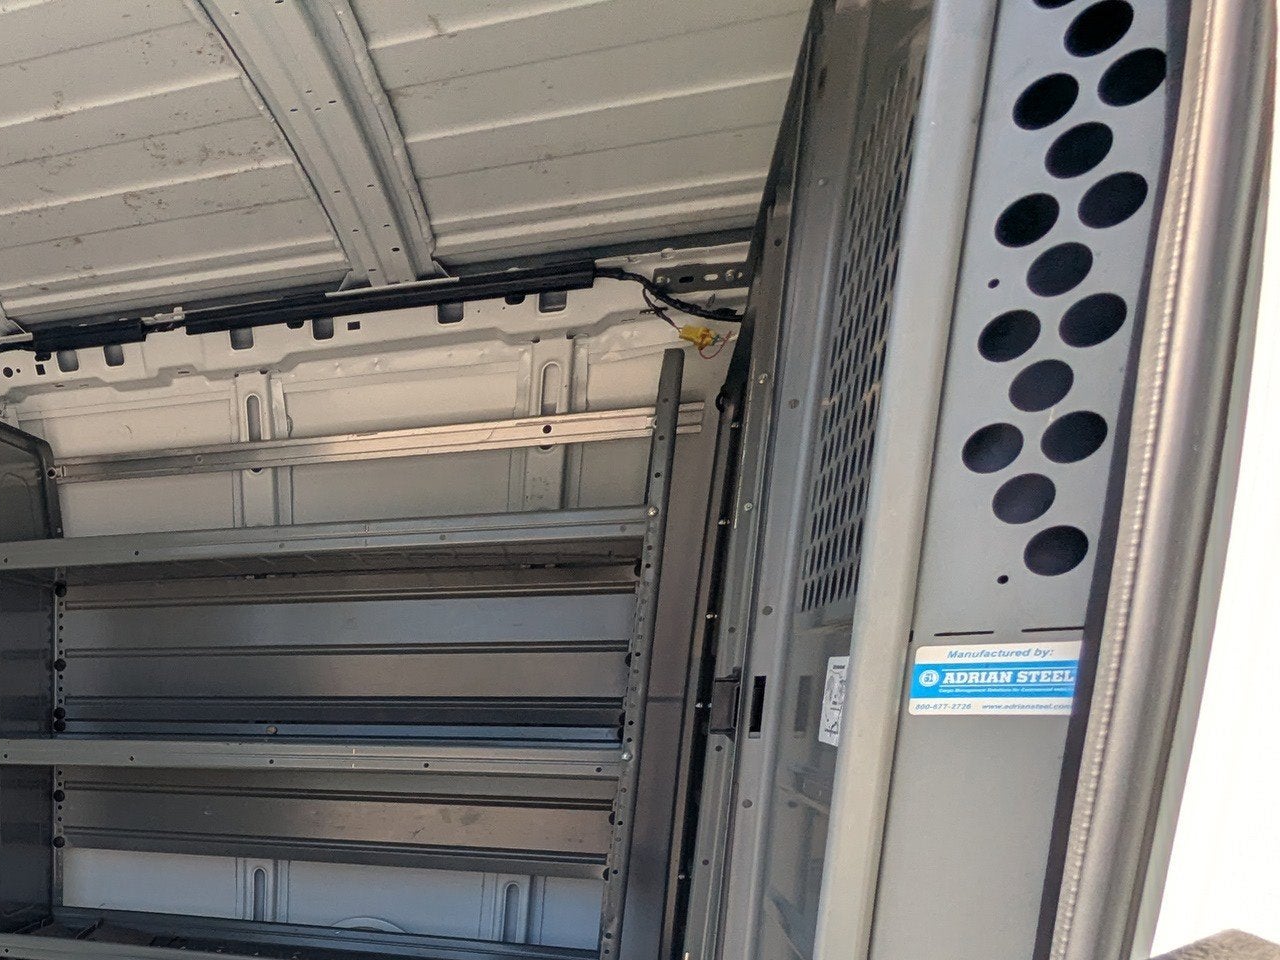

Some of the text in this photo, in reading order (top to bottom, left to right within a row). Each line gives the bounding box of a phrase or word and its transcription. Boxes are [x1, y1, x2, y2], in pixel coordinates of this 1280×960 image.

[947, 648, 1054, 659] Manufactured by:
[943, 669, 1074, 685] ADRIAN STEEL
